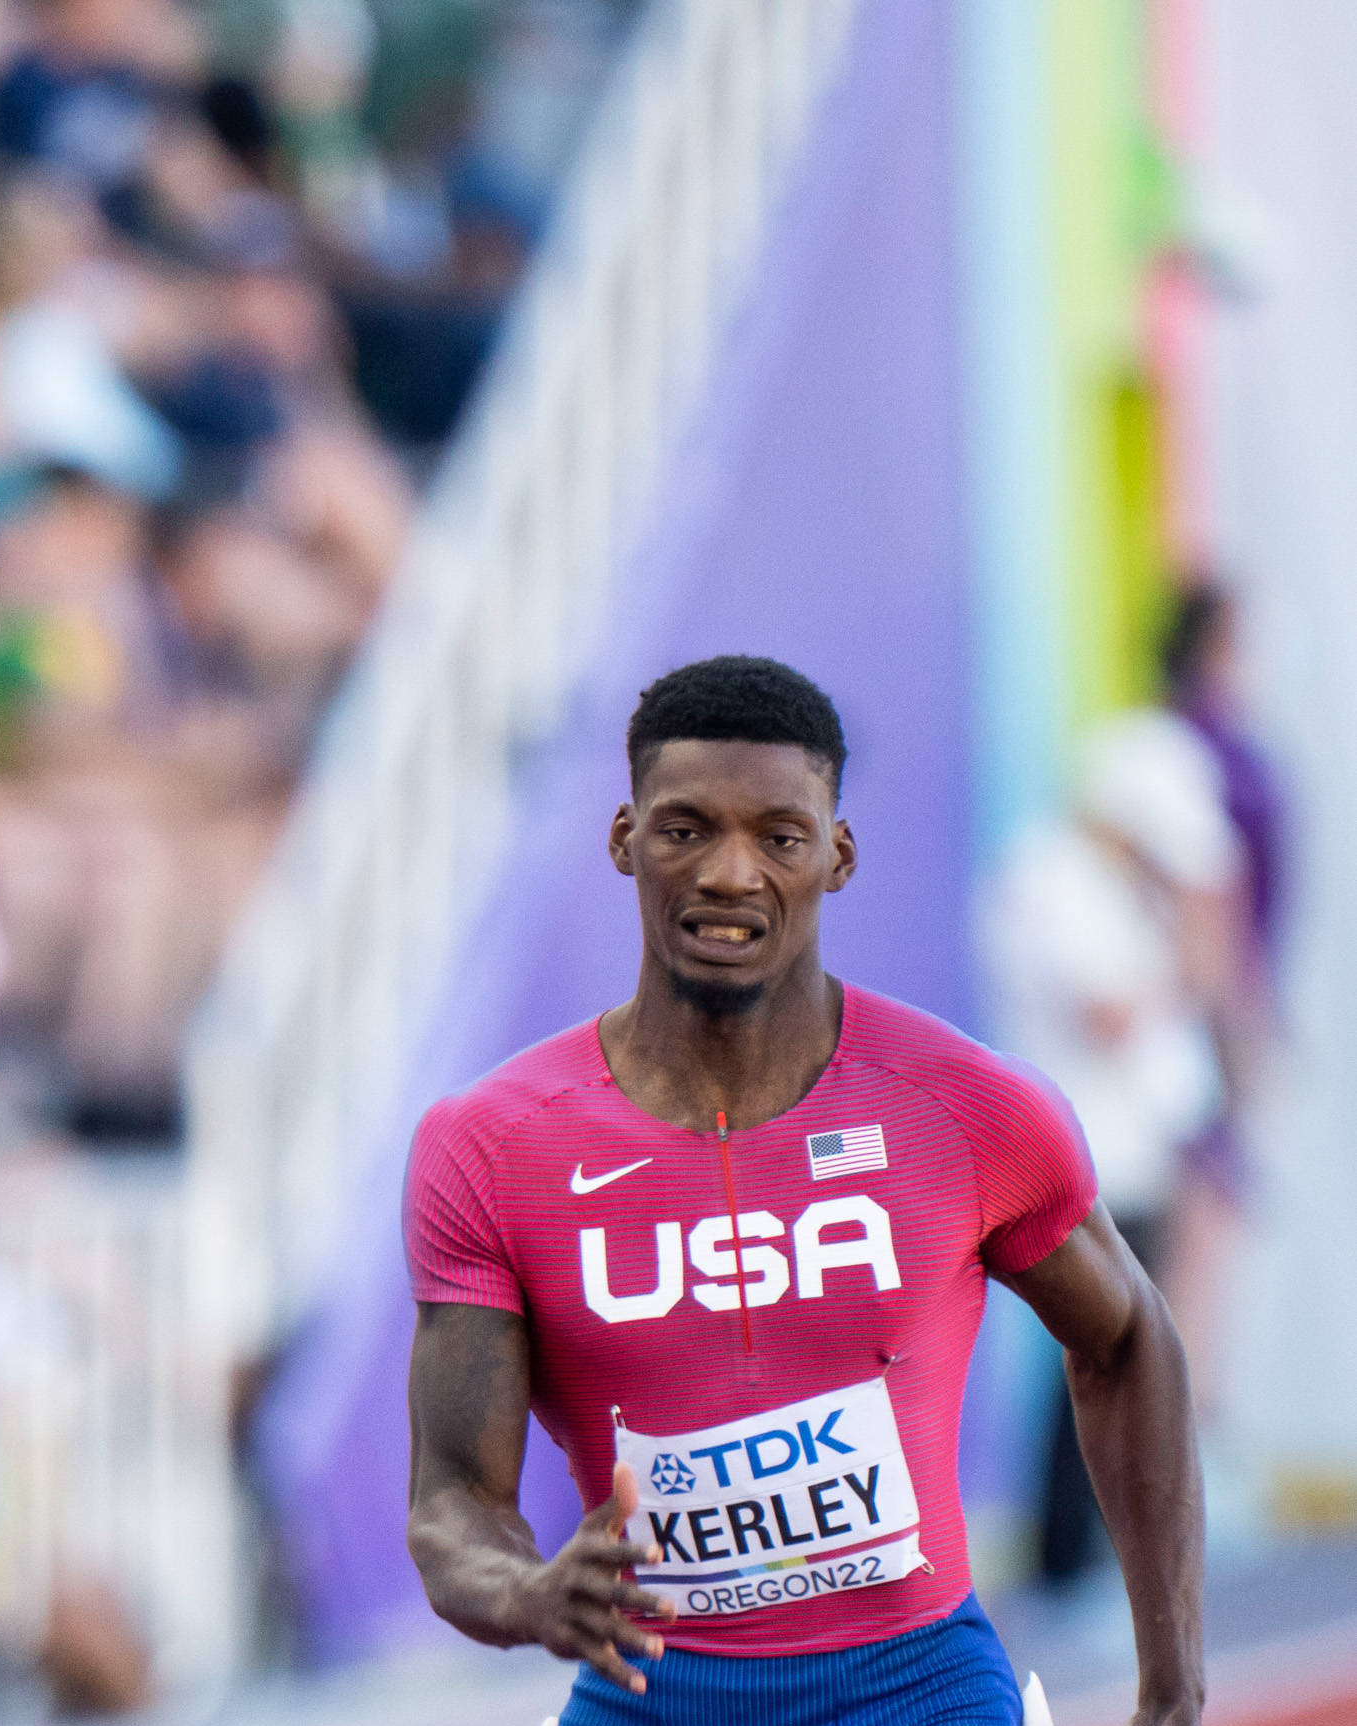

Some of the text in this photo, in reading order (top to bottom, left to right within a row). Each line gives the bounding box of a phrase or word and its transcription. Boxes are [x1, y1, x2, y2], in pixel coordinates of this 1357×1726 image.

[580, 1195, 902, 1323] USA
[690, 1408, 857, 1488] TDK
[648, 1464, 881, 1564] KERLEY
[687, 1556, 885, 1614] OREGON22
